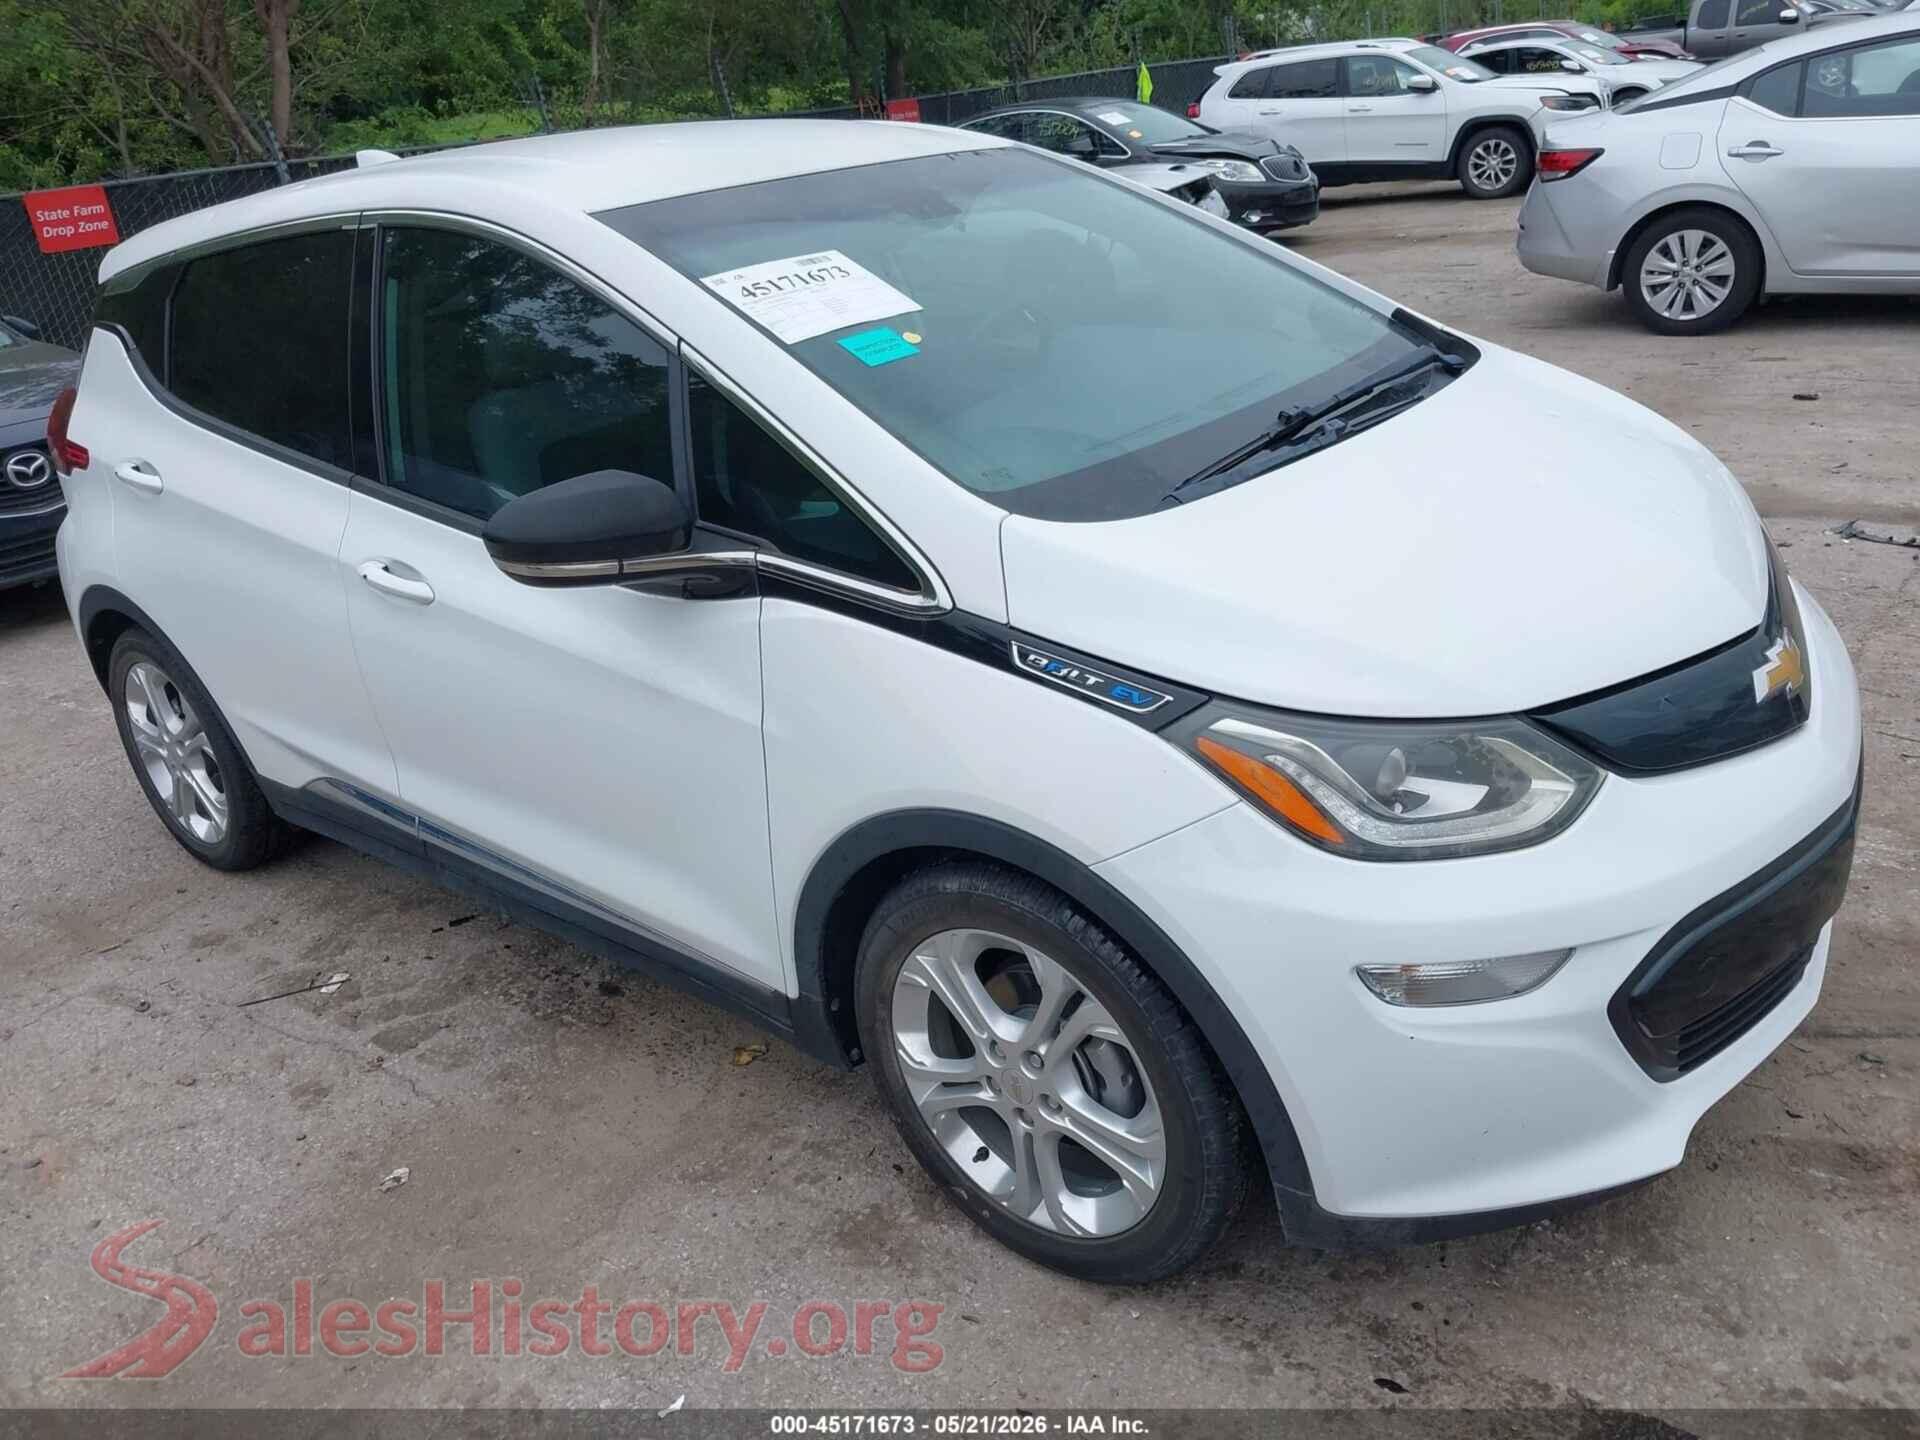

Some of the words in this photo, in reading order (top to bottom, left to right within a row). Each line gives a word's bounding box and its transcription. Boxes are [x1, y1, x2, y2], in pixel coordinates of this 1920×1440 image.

[36, 208, 71, 222] State
[73, 204, 105, 217] Farm
[42, 225, 75, 238] Drop
[78, 220, 109, 233] Zone
[740, 265, 850, 298] 45171673
[1026, 653, 1105, 687] BOLT
[1110, 683, 1153, 705] EV
